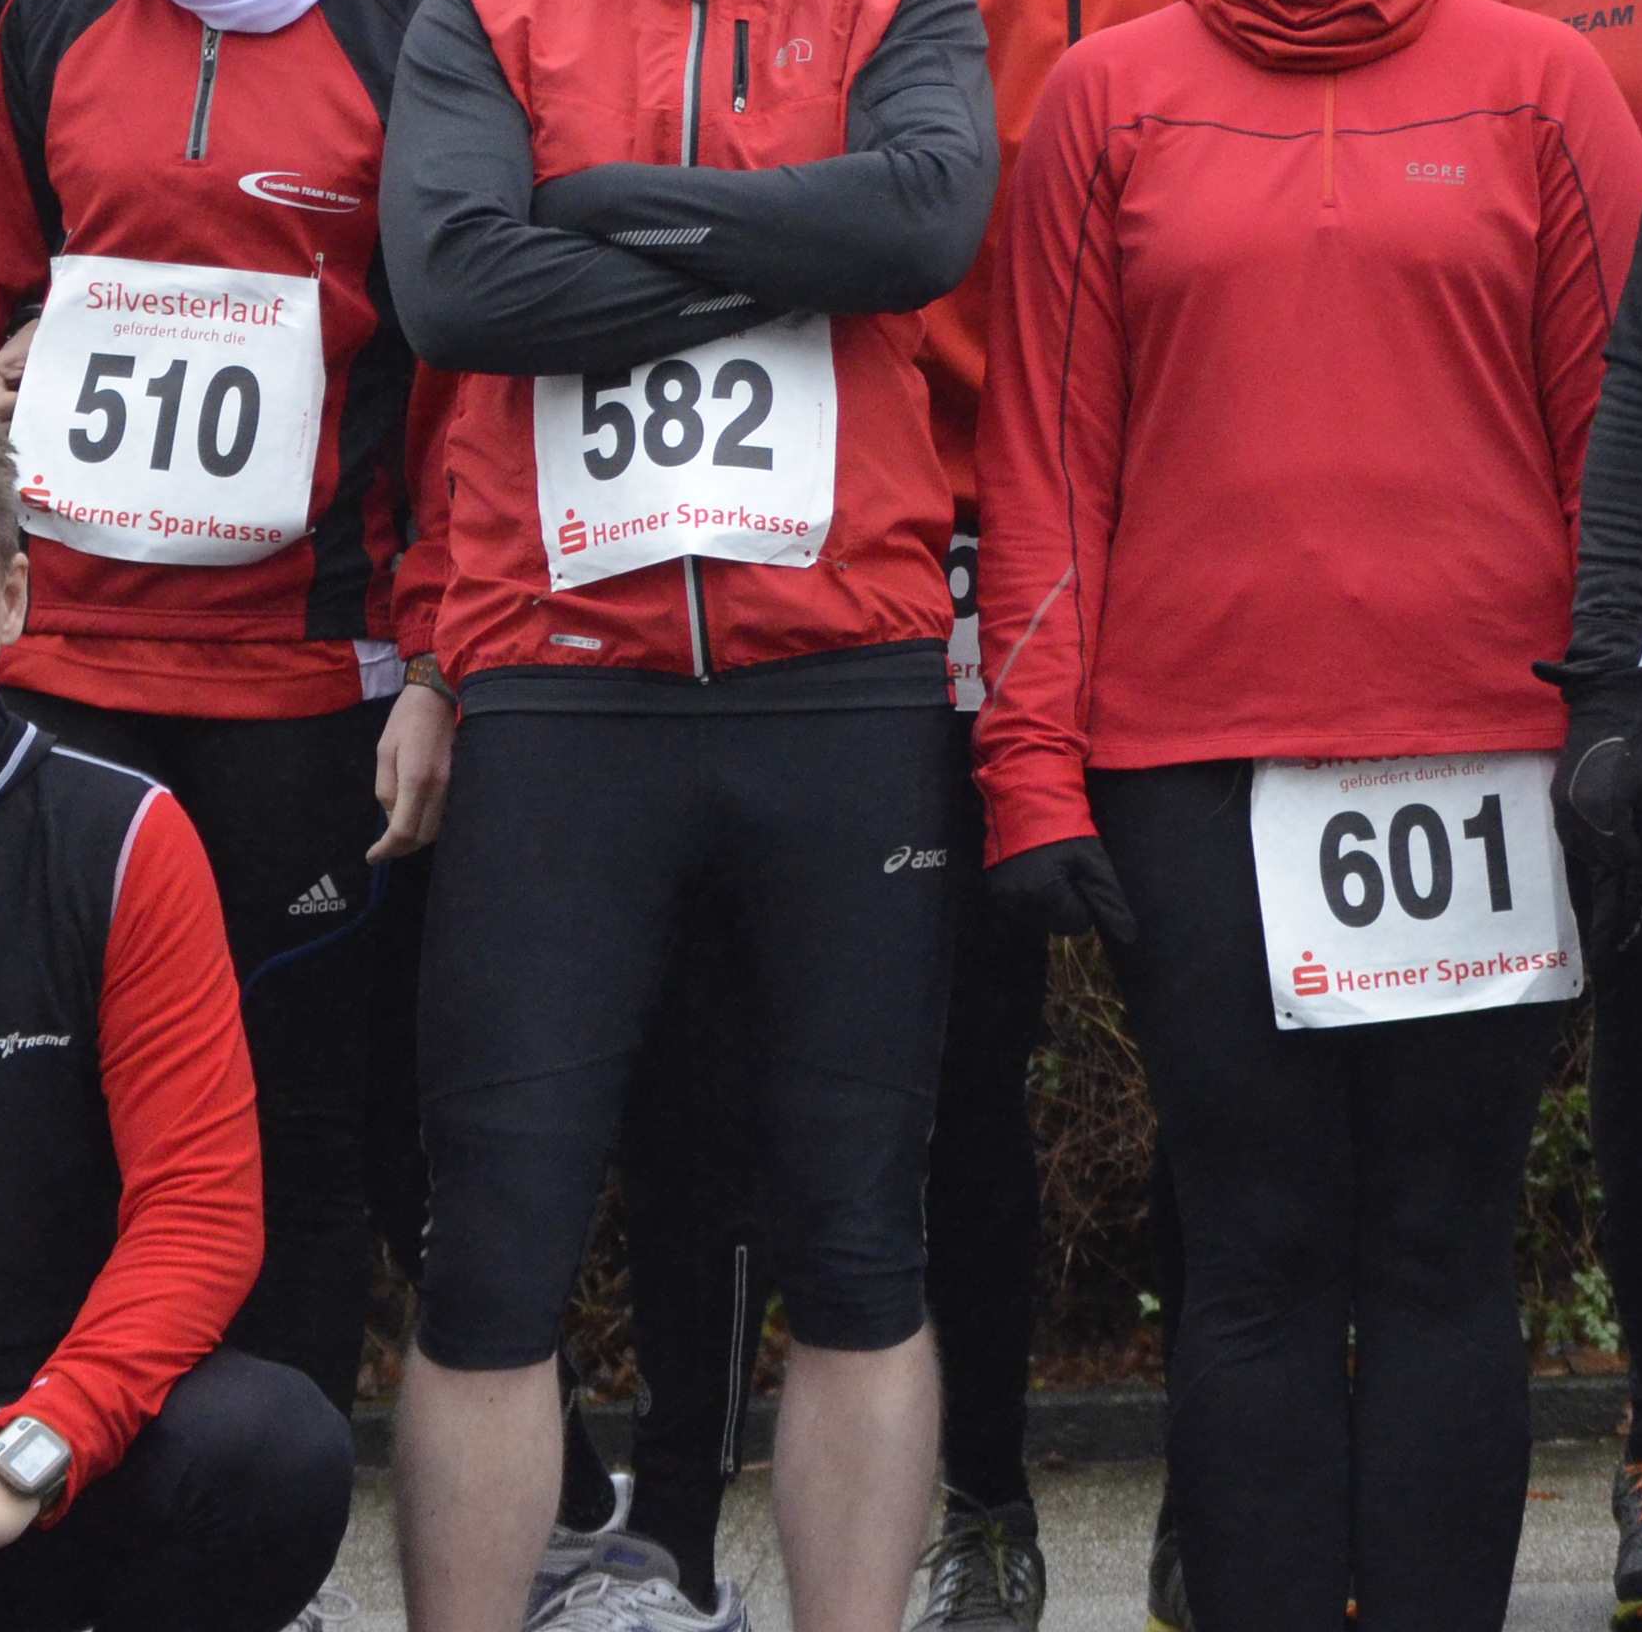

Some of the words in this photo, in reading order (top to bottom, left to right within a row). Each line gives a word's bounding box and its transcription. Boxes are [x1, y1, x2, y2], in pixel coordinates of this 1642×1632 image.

[1405, 162, 1467, 178] GORE
[86, 281, 285, 327] Silvesterlauf
[113, 321, 177, 339] gefördert
[180, 325, 220, 343] durch
[223, 331, 246, 346] die
[68, 352, 261, 478] 510
[581, 358, 774, 481] 582
[57, 499, 142, 529] Herner
[148, 509, 283, 544] Sparkasse
[593, 511, 670, 546] Herner
[676, 503, 810, 537] Sparkasse
[1339, 771, 1412, 792] gefördert
[1414, 765, 1458, 782] durch
[1460, 762, 1486, 776] die
[1319, 794, 1513, 928] 601
[287, 898, 348, 916] adidas
[1336, 967, 1429, 993] Herner
[1437, 952, 1570, 982] Sparkasse
